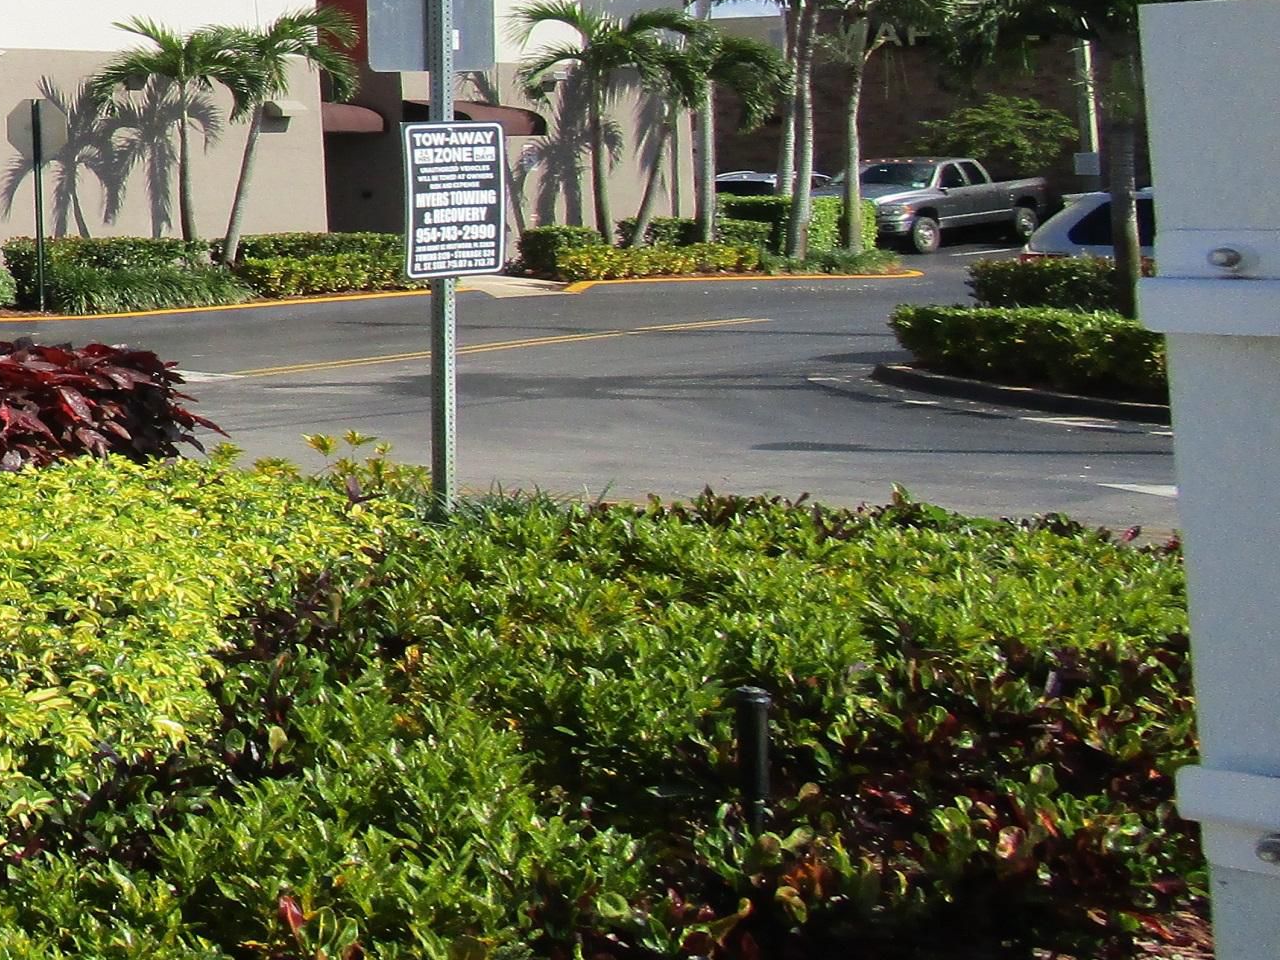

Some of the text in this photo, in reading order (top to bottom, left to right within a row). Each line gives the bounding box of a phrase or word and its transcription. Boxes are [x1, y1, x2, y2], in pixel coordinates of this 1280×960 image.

[412, 131, 495, 147] TOW-AWAY
[433, 147, 473, 163] ZONE
[460, 164, 491, 172] VEHICLES
[415, 189, 497, 209] MYERS TOWING
[423, 206, 488, 225] & RECOVERY
